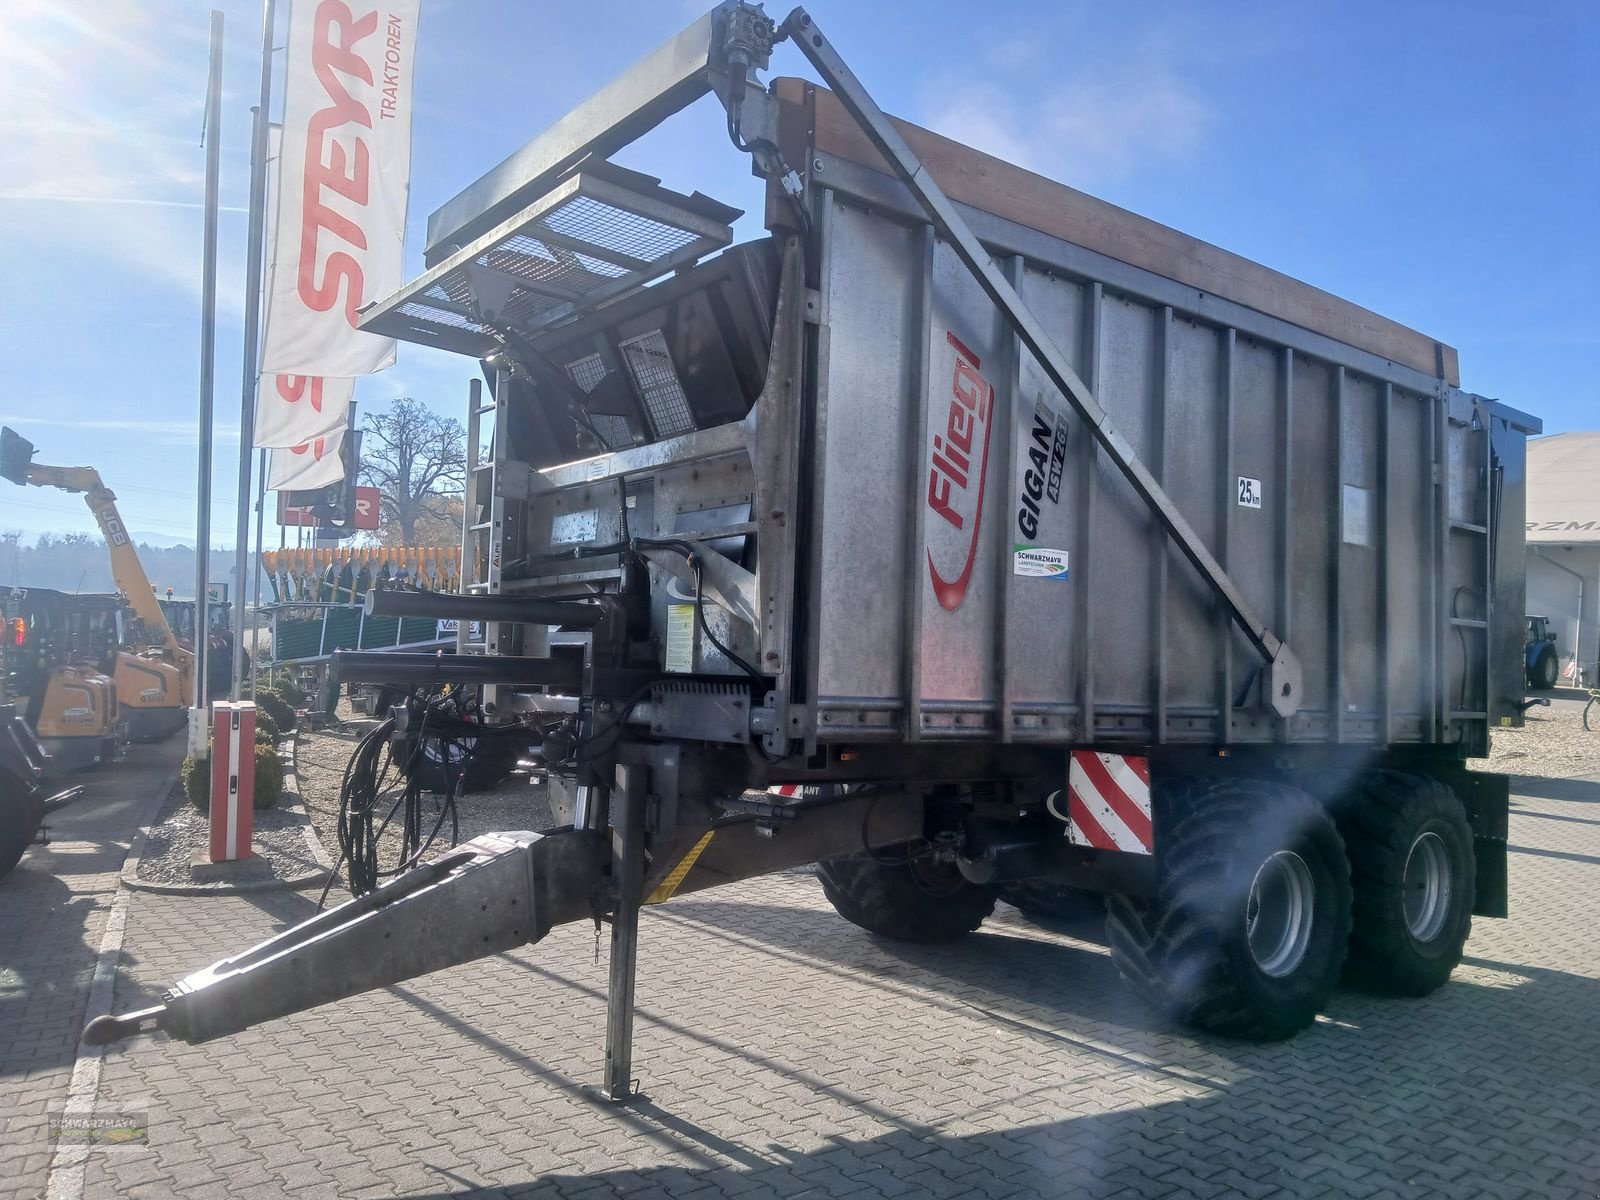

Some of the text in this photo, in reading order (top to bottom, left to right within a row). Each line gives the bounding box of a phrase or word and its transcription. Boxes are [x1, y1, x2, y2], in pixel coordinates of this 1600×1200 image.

[380, 14, 402, 120] TRAKTOREN
[298, 0, 378, 330] STEYR
[928, 330, 987, 530] Fliegl
[1018, 391, 1055, 540] GIGANT
[1050, 456, 1062, 503] ASW
[1240, 479, 1252, 503] 25
[102, 511, 127, 546] JCB
[1017, 552, 1062, 563] SCHWARZMAYR
